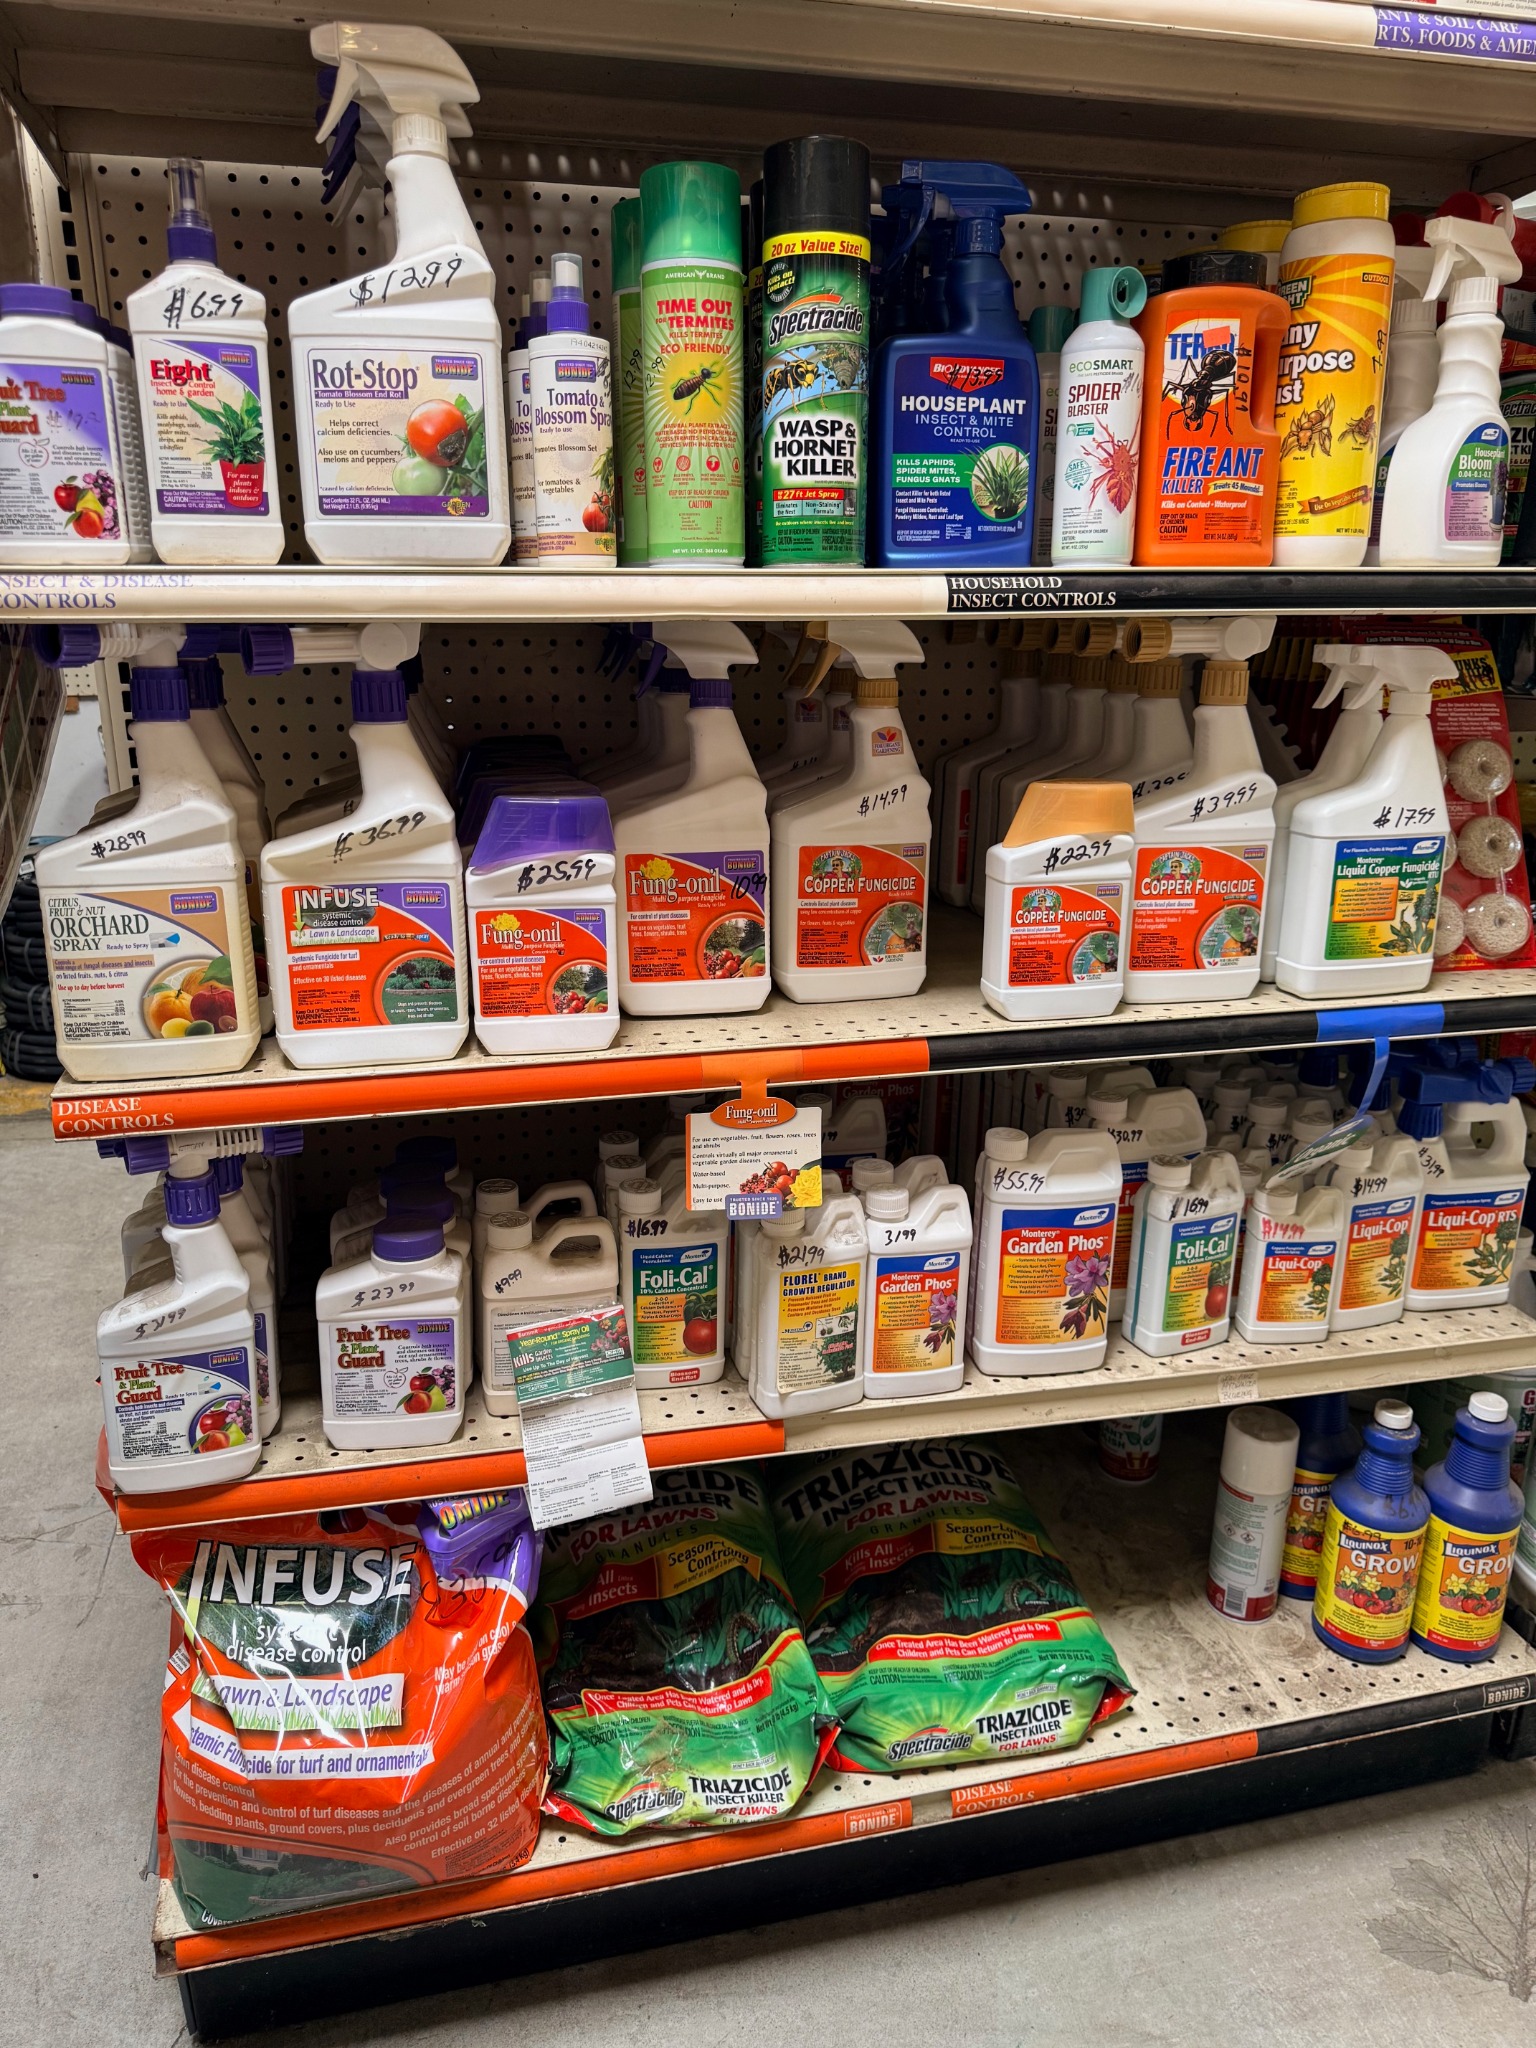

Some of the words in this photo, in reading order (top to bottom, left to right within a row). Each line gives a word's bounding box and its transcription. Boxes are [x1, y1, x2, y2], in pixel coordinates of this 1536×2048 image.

[1418, 29, 1475, 49] FOODS
[1480, 36, 1492, 51] &
[771, 245, 784, 257] 20
[800, 239, 836, 253] Value
[839, 240, 862, 256] Size!
[665, 272, 696, 280] AMERICAN
[164, 288, 243, 329] $6.99
[657, 299, 696, 316] TIME
[701, 299, 732, 316] OUT
[668, 315, 734, 332] TERMITES
[769, 304, 863, 347] Spectracide
[689, 331, 723, 339] TERMITES
[660, 344, 681, 354] ECO
[684, 344, 731, 355] FRIENDLY
[151, 360, 213, 386] Eight
[312, 358, 418, 398] Rot-Stop
[434, 364, 475, 377] BONIDE
[187, 387, 215, 398] garden
[547, 388, 597, 408] Tomato
[1068, 383, 1120, 403] SPIDER
[901, 395, 1026, 416] HOUSEPLANT
[1068, 402, 1108, 417] BLASTER
[329, 420, 349, 429] Helps
[535, 408, 587, 427] Blossom
[916, 415, 966, 425] INSECT
[983, 416, 1013, 427] MITE
[317, 428, 345, 436] calcium
[779, 419, 841, 438] WASP
[845, 421, 856, 439] &
[933, 427, 996, 438] CONTROL
[774, 440, 856, 458] HORNET
[788, 457, 855, 477] KILLER
[922, 459, 956, 467] APHIDS,
[1163, 446, 1218, 478] FIRE
[1218, 447, 1265, 477] ANT
[1459, 455, 1492, 472] Bloom
[1161, 479, 1204, 495] KILLER
[1159, 526, 1188, 534] CAUTION
[103, 575, 194, 588] DISEASE
[951, 576, 1062, 589] HOUSEHOLD
[951, 593, 1016, 608] INSECT
[1021, 592, 1116, 606] CONTROLS
[857, 784, 908, 817] $14.99
[1190, 782, 1257, 822] $39.99
[1337, 864, 1367, 877] Liquid
[1369, 863, 1401, 876] Copper
[1402, 861, 1440, 874] Fungicide
[629, 869, 721, 902] Fung-onil
[804, 876, 855, 893] COPPER
[857, 876, 916, 893] FUNGICIDE
[1141, 878, 1193, 895] COPPER
[1195, 878, 1256, 894] FUNGICIDE
[48, 898, 81, 908] CITRUS,
[174, 899, 213, 911] BONIDE
[294, 888, 380, 910] INFUSE
[406, 895, 441, 904] BONIDE
[49, 907, 75, 916] FRUIT
[86, 906, 105, 916] NUT
[322, 912, 352, 921] systemic
[1016, 910, 1055, 924] COPPER
[1057, 910, 1107, 922] FUNGICIDE
[50, 913, 150, 938] ORCHARD
[313, 919, 338, 927] disease
[340, 918, 364, 927] control
[310, 929, 329, 937] Lawn
[337, 928, 375, 938] Landscape
[481, 921, 562, 950] Fung-onil
[53, 938, 102, 951] SPRAY
[57, 1097, 142, 1117] DISEASE
[725, 1103, 778, 1122] Fung-onil
[58, 1113, 174, 1134] CONTROLS
[993, 1167, 1045, 1193] $55.99
[1351, 1177, 1387, 1197] $14.99
[729, 1202, 776, 1216] BONIDE
[1428, 1209, 1496, 1227] Liqui-Cop
[1497, 1209, 1517, 1222] RTS
[1021, 1230, 1058, 1238] Monterey
[1352, 1219, 1409, 1240] Liqui-Cop
[1007, 1237, 1063, 1254] Garden
[1068, 1235, 1104, 1252] Phos
[1176, 1236, 1231, 1260] Foli-Cal
[1268, 1257, 1322, 1271] Liqui-Cop
[640, 1266, 708, 1289] Foli-Cal
[783, 1273, 818, 1286] FLOREL
[824, 1271, 847, 1282] BRAND
[880, 1280, 922, 1294] Garden
[924, 1277, 953, 1291] Phos
[891, 1273, 921, 1283] Monterey
[783, 1285, 817, 1297] GROWTH
[819, 1279, 855, 1294] REGULATOR
[336, 1324, 374, 1343] Fruit
[378, 1325, 410, 1341] Tree
[338, 1353, 385, 1369] Guard
[114, 1363, 149, 1383] Fruit
[153, 1363, 184, 1376] Tree
[116, 1385, 163, 1404] Guard
[781, 1444, 1016, 1524] TRIAZICIDE
[912, 1472, 996, 1497] KILLER
[844, 1504, 895, 1531] FOR
[1340, 1532, 1388, 1551] LIQUINOX
[1445, 1542, 1496, 1556] LIQUINOX
[1351, 1550, 1419, 1574] GROW
[187, 1539, 417, 1607] INFUSE
[1488, 1686, 1526, 1704] BONIDE
[976, 1698, 1073, 1734] TRIAZICIDE
[990, 1727, 1027, 1744] INSECT
[1027, 1720, 1062, 1738] KILLER
[1020, 1735, 1056, 1747] LAWNS
[887, 1732, 972, 1762] Spectracide
[276, 1758, 294, 1774] for
[299, 1757, 324, 1774] turf
[327, 1756, 352, 1773] and
[688, 1767, 791, 1794] TRIAZICIDE
[705, 1794, 746, 1805] INSECT
[747, 1792, 785, 1804] KILLER
[955, 1780, 1014, 1801] DISEASE
[956, 1791, 1035, 1813] CONTROLS
[849, 1813, 897, 1834] BONIDE
